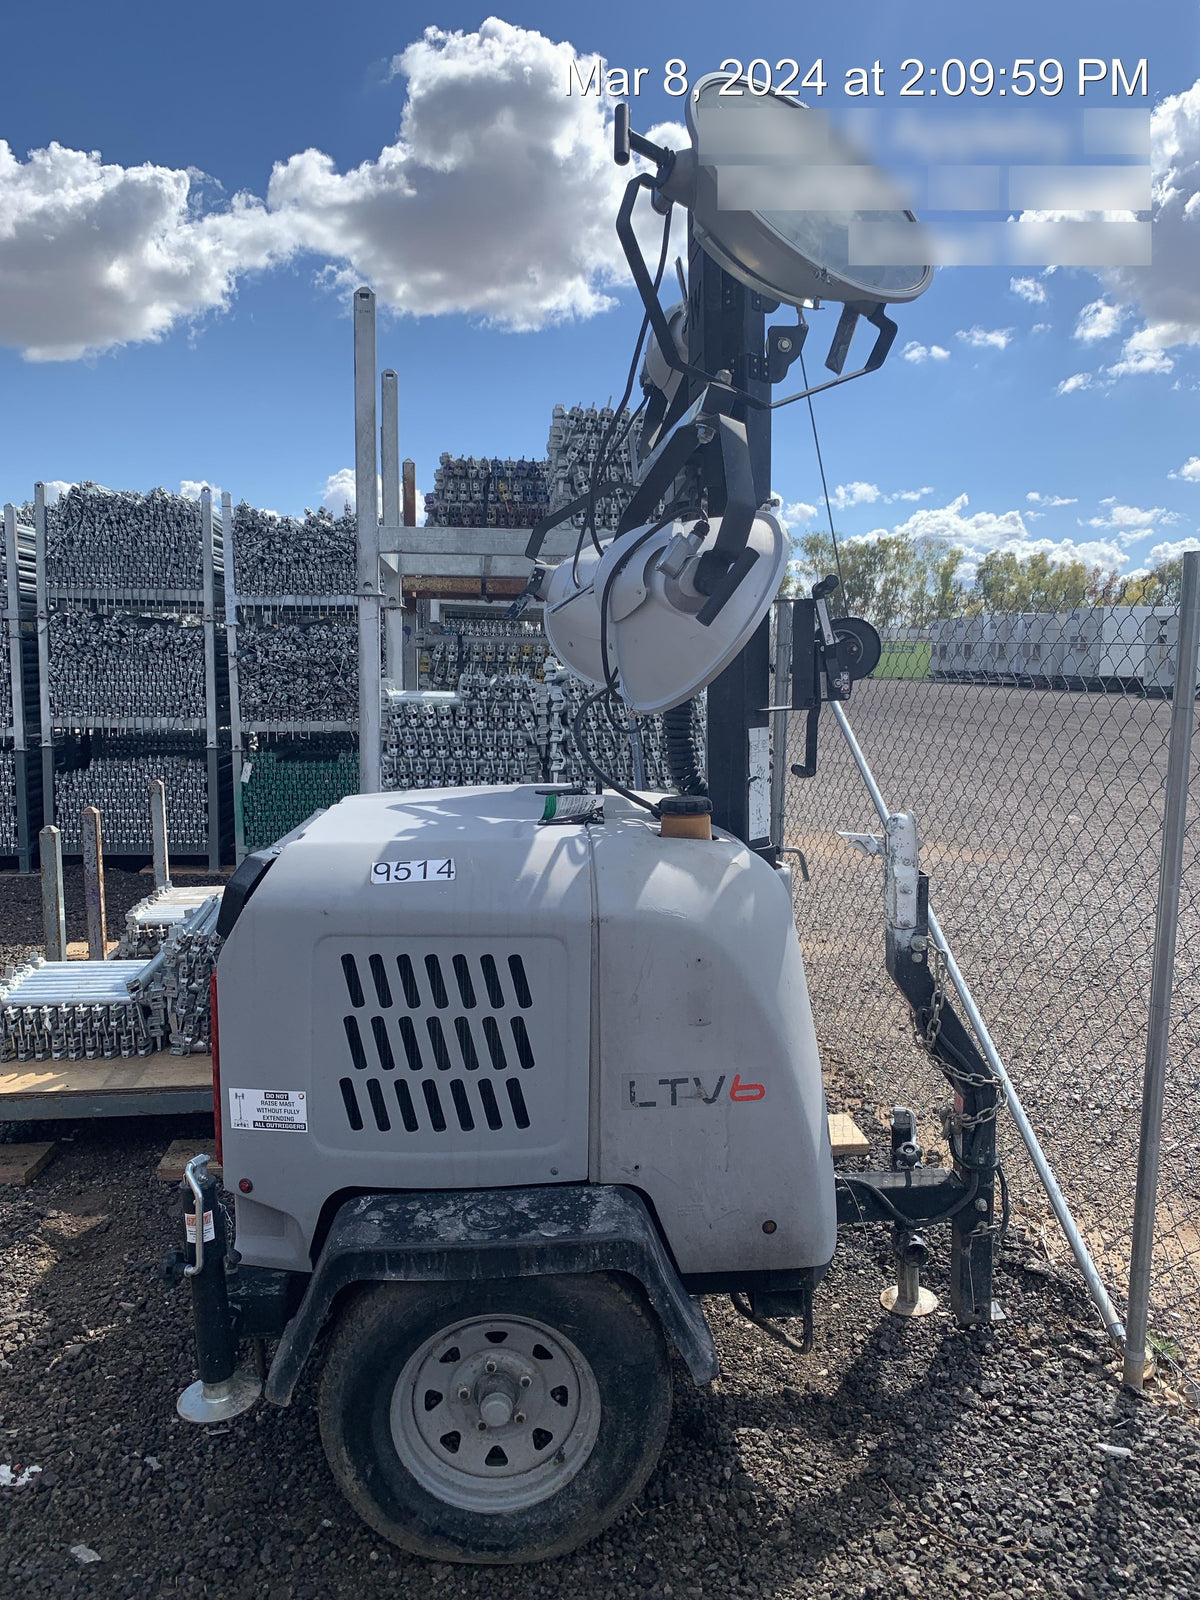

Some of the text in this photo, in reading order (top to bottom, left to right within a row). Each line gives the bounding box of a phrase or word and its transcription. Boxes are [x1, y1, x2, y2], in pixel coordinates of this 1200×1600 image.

[373, 858, 455, 882] 9514
[629, 1073, 766, 1108] LTV6
[266, 1122, 305, 1130] OUTRIGGERS
